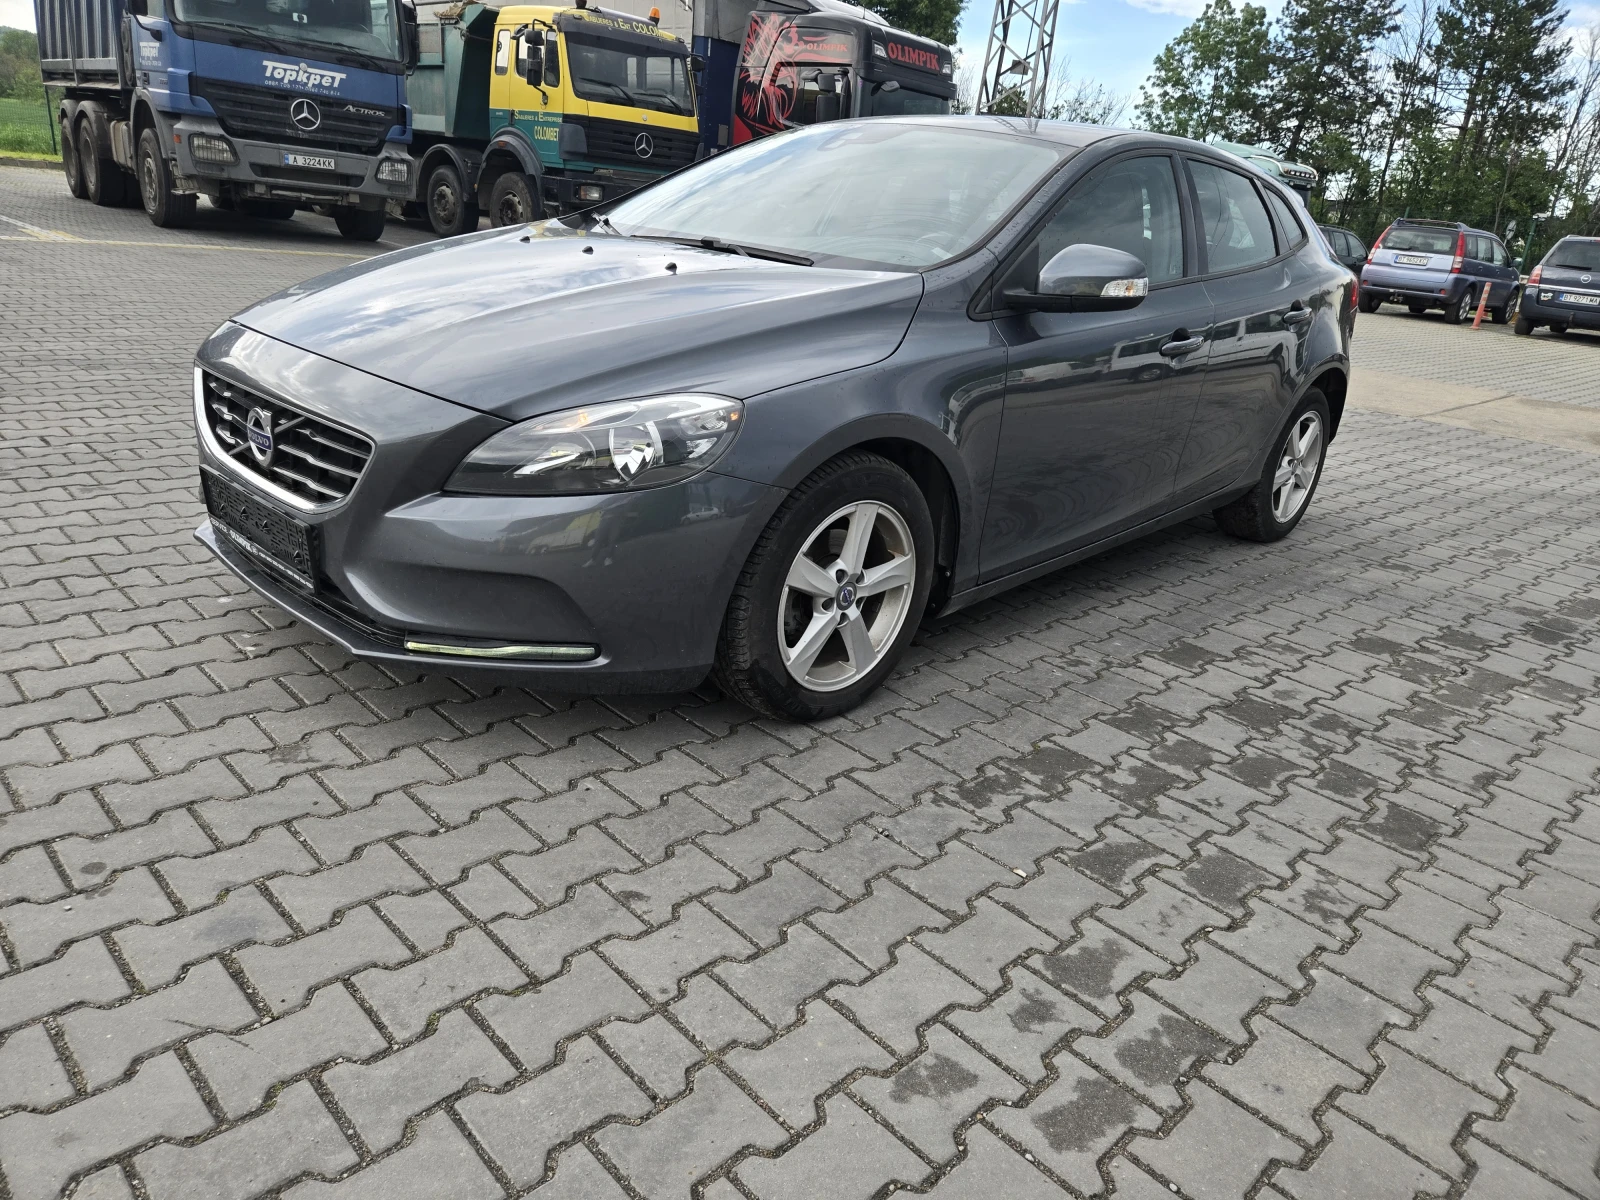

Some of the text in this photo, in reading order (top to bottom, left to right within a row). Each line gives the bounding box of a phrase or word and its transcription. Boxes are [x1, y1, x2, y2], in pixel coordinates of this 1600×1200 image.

[806, 42, 847, 52] OLIMPIK
[887, 42, 939, 71] OLIMPIK
[534, 125, 560, 142] COLOMBET
